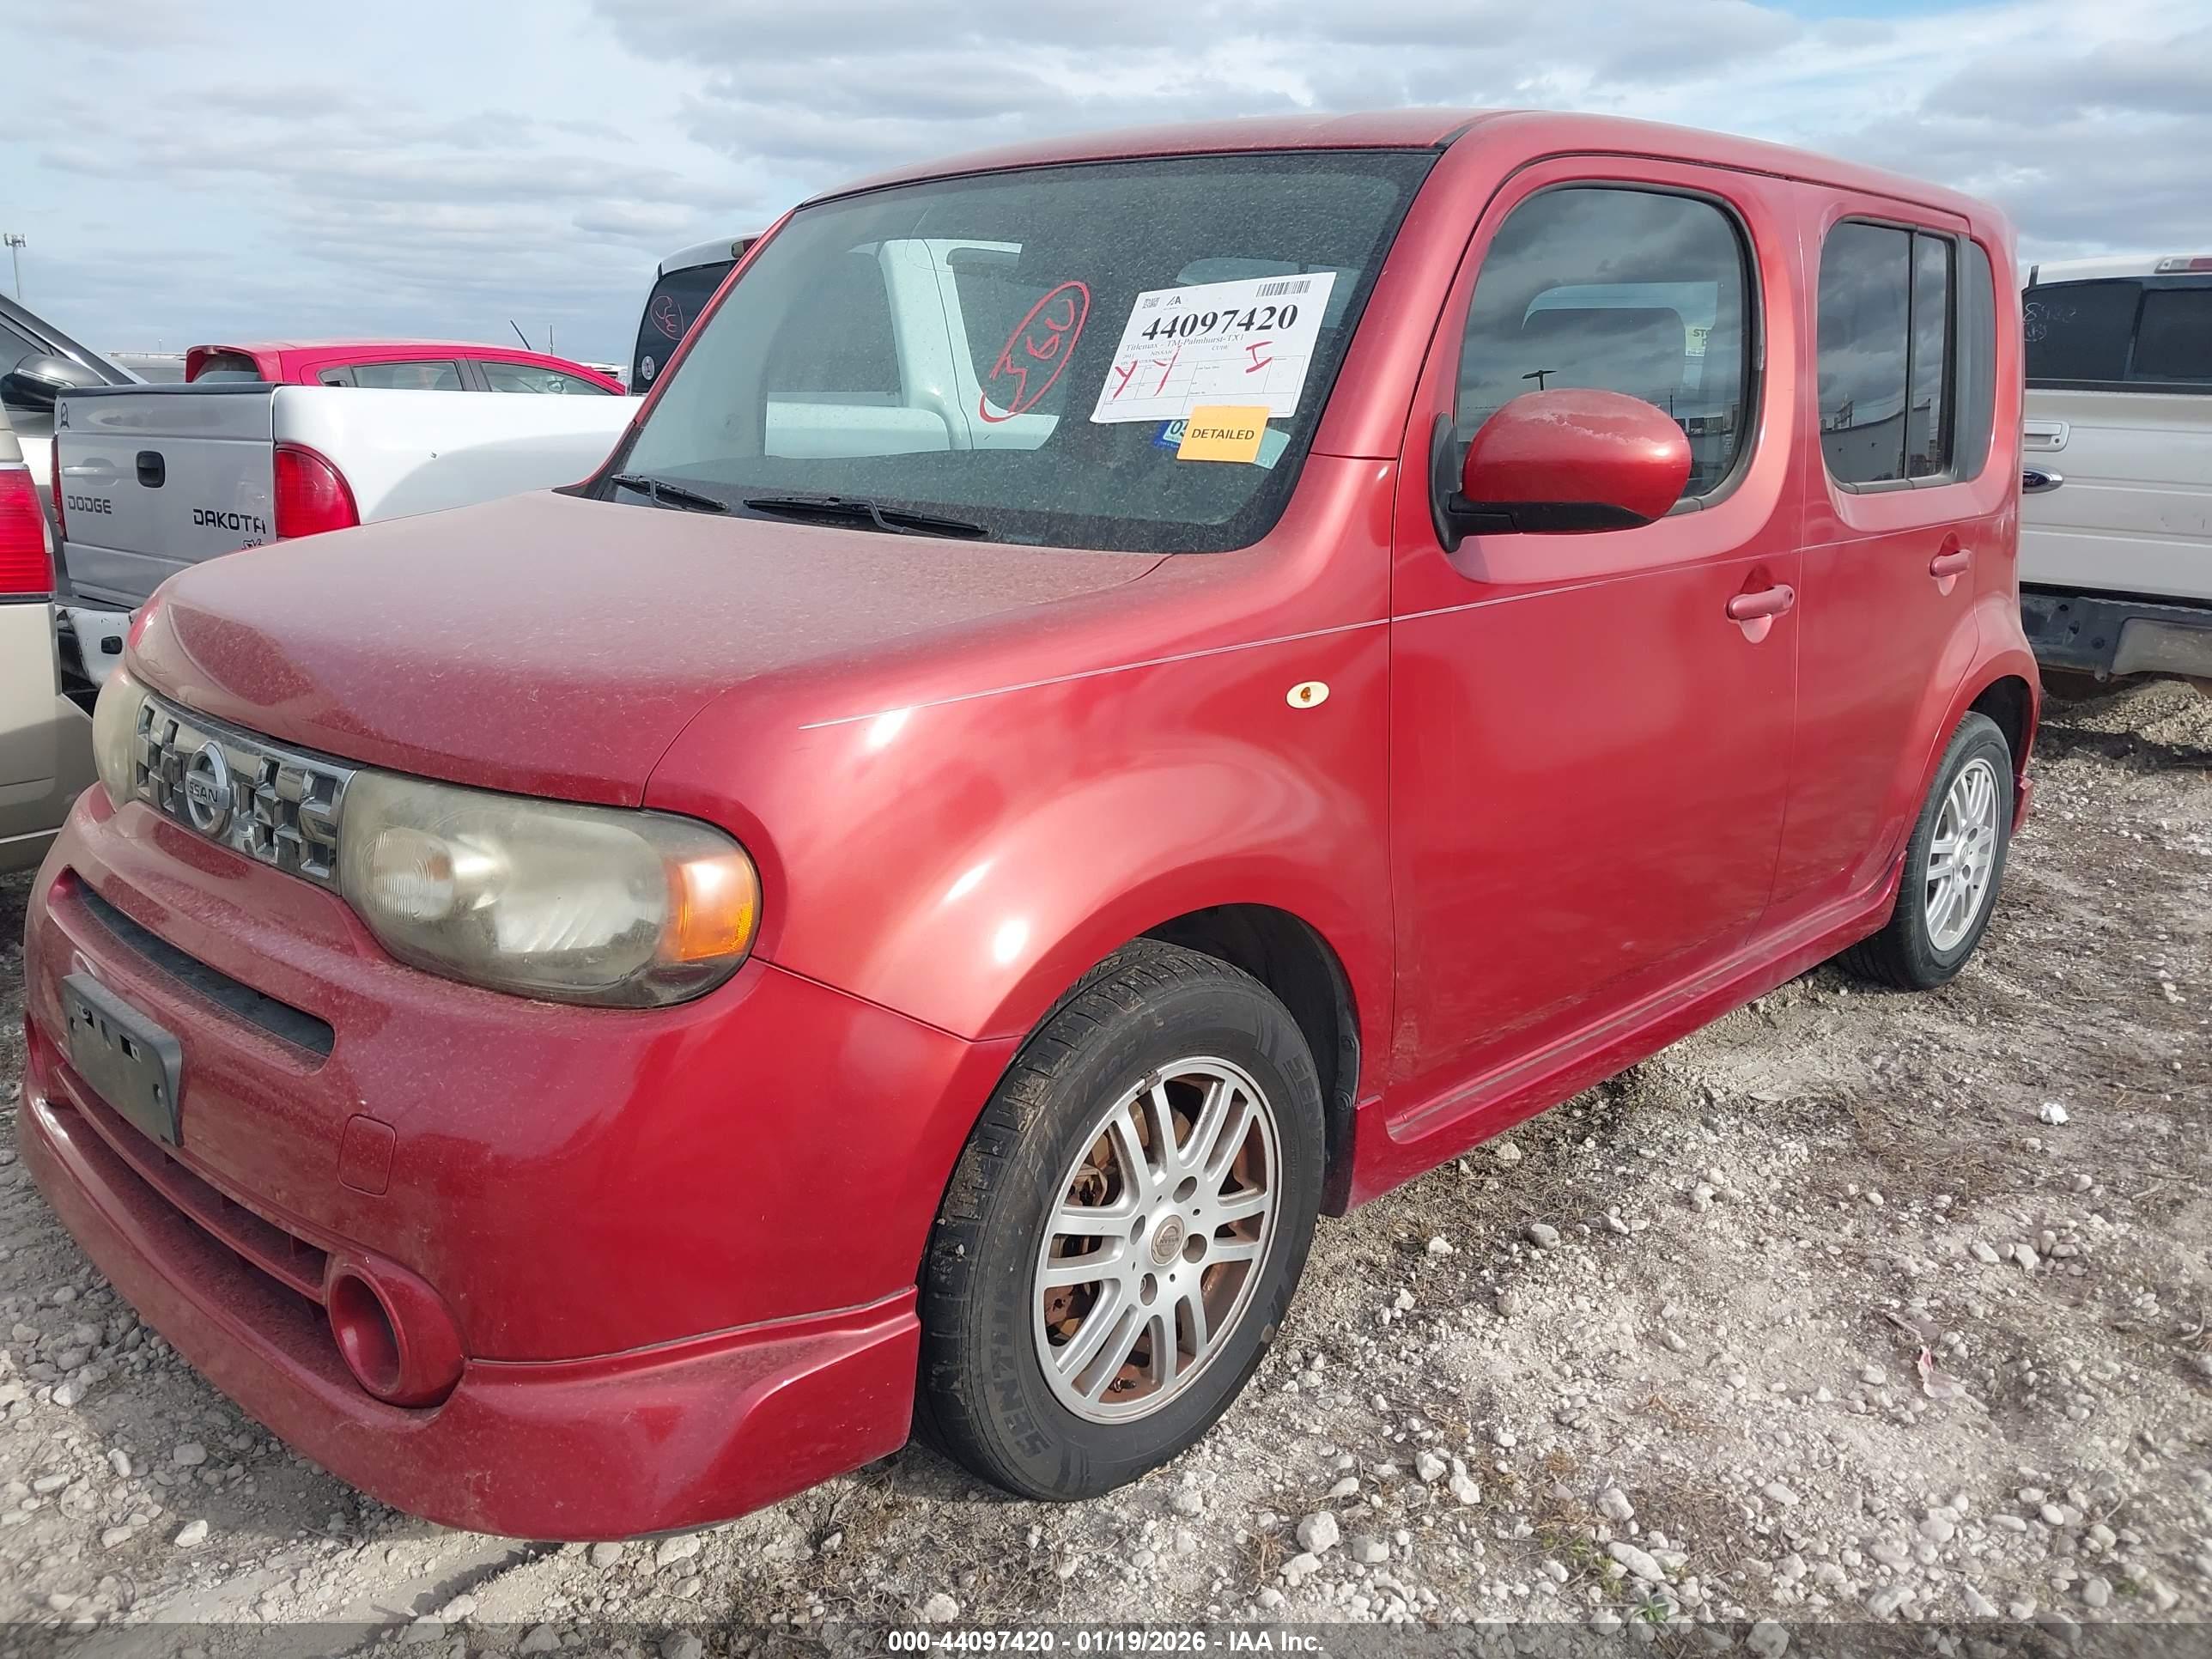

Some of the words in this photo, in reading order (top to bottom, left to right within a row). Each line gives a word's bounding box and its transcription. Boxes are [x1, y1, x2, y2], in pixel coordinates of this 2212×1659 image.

[1141, 304, 1299, 341] 44097420
[1191, 428, 1255, 441] DETAILED
[67, 495, 112, 514] DODGE
[192, 508, 266, 534] DAKOTA
